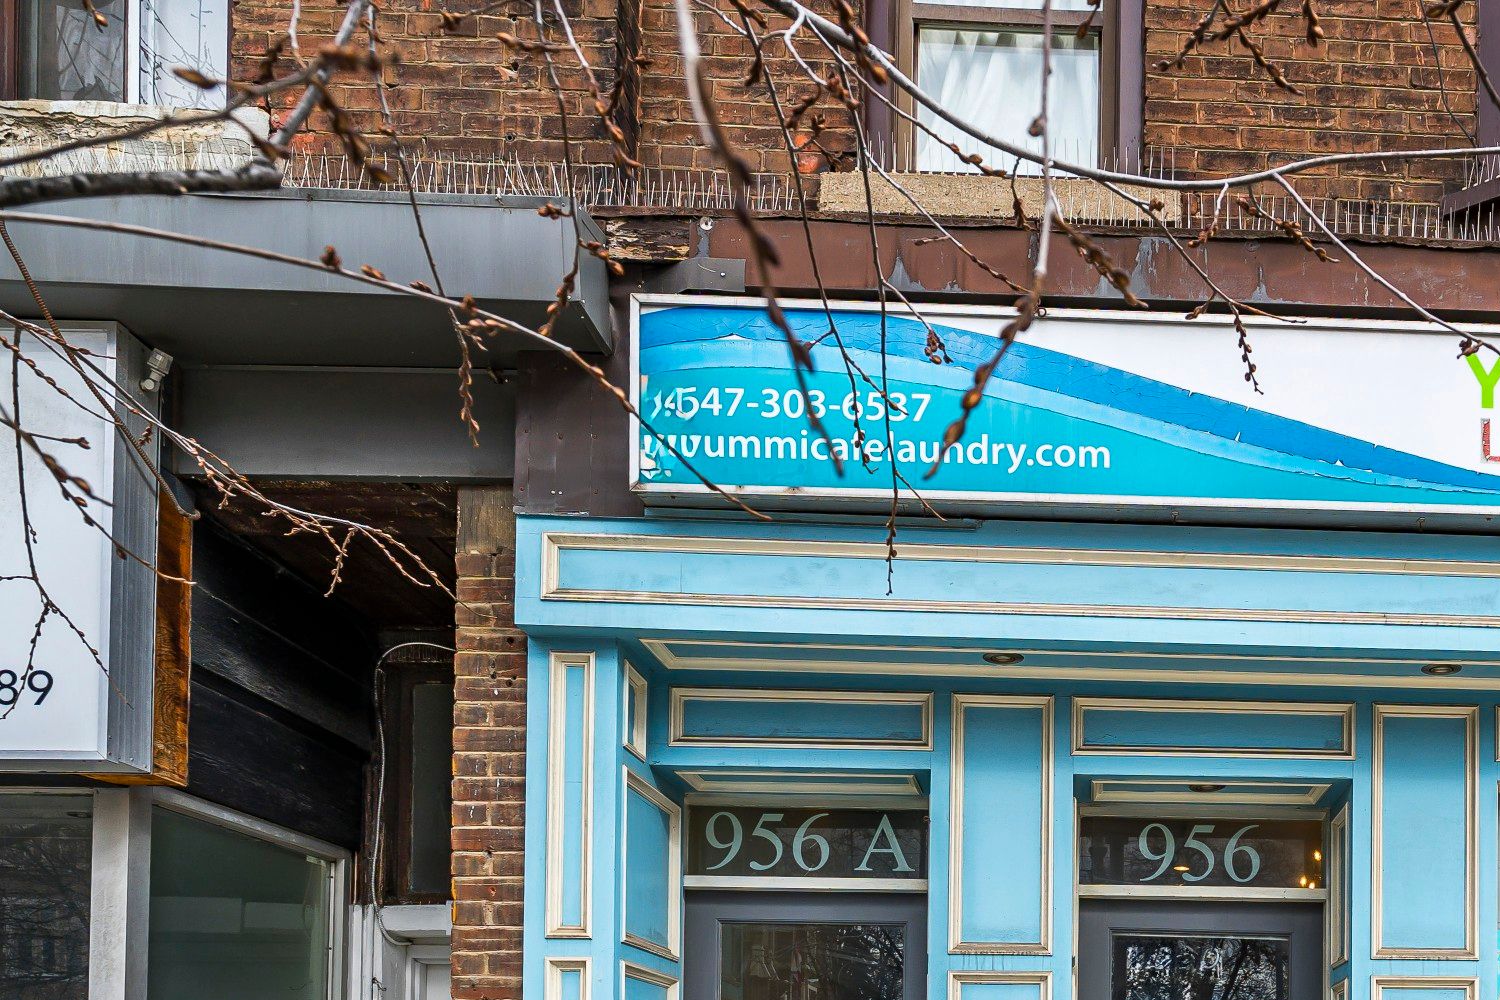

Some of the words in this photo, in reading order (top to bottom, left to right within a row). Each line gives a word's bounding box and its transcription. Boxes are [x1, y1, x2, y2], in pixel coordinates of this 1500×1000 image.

[705, 811, 831, 872] 956
[854, 814, 916, 873] A
[1137, 823, 1261, 883] 956
